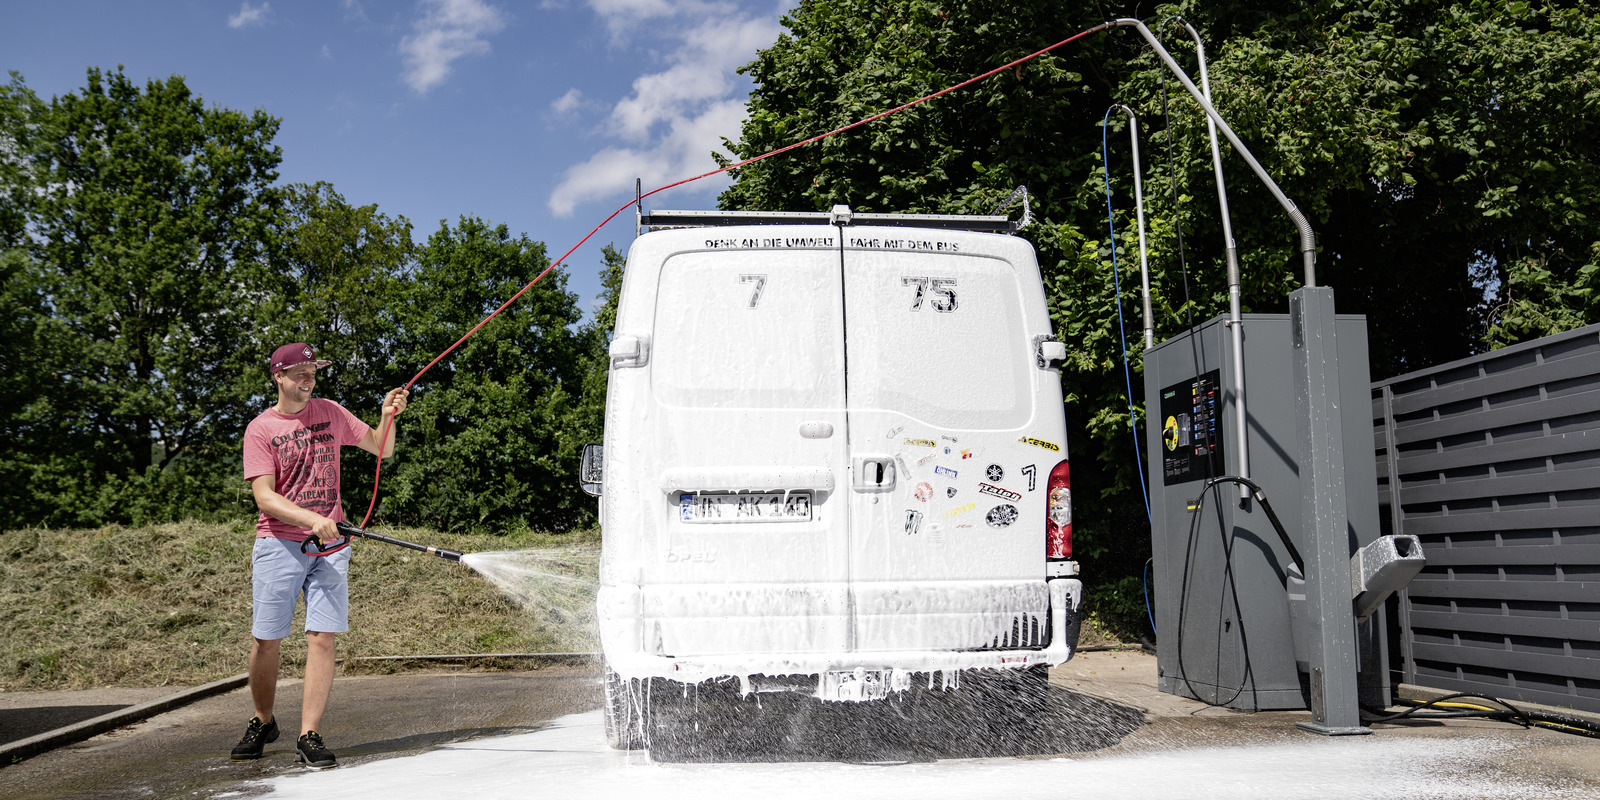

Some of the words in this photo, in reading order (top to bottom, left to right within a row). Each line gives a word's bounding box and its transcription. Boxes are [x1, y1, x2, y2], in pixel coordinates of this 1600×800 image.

[705, 238, 737, 248] DENK
[742, 238, 759, 248] AN
[763, 238, 782, 248] DIE
[786, 237, 834, 247] UMWELT
[850, 238, 880, 249] FAHR
[884, 239, 904, 249] MIT
[908, 240, 933, 250] DEM
[937, 241, 960, 251] BUS
[739, 274, 768, 310] 7
[901, 276, 959, 314] 75
[295, 433, 335, 450] DIVISION
[1018, 436, 1060, 452] ACERBIS
[1020, 464, 1036, 492] 7
[297, 489, 326, 501] STREAM
